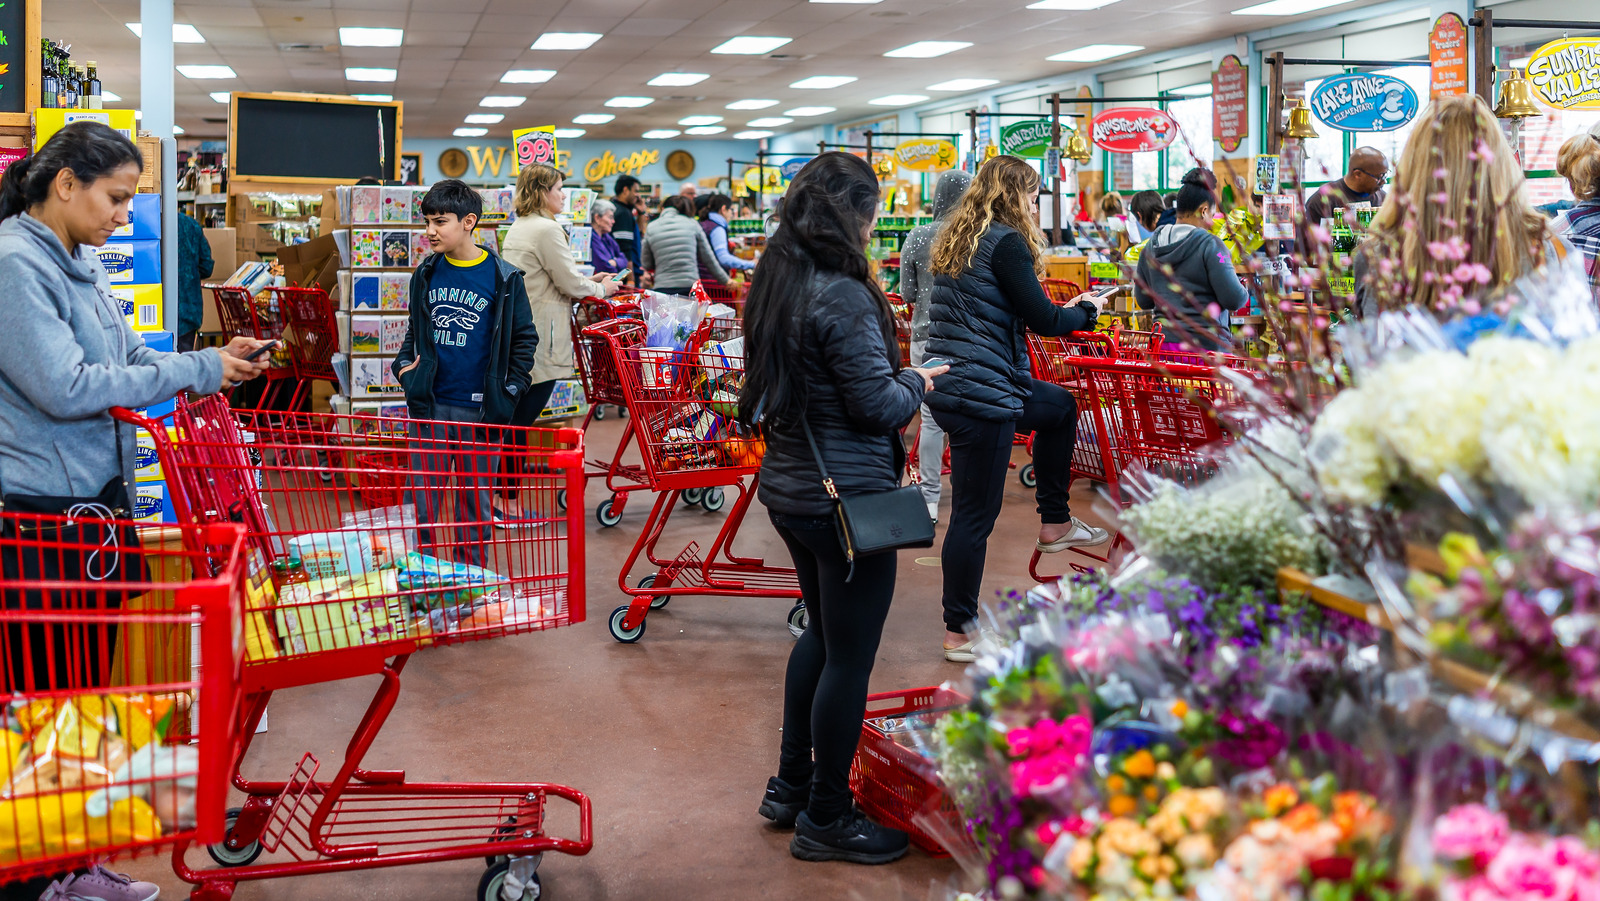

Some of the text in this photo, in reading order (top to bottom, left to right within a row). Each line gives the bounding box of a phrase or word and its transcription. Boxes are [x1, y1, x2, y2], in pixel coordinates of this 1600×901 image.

[1540, 68, 1600, 104] VALLE
[1312, 76, 1385, 121] LAKE ANNE
[1332, 101, 1375, 123] ELEMENTARY
[1092, 116, 1150, 143] ARMSTRONG
[466, 145, 661, 182] WIE Shoppe
[97, 253, 127, 262] PARKLING
[428, 287, 489, 312] UNNING
[433, 329, 467, 347] WILD
[137, 447, 153, 456] LING
[136, 497, 156, 505] KLING
